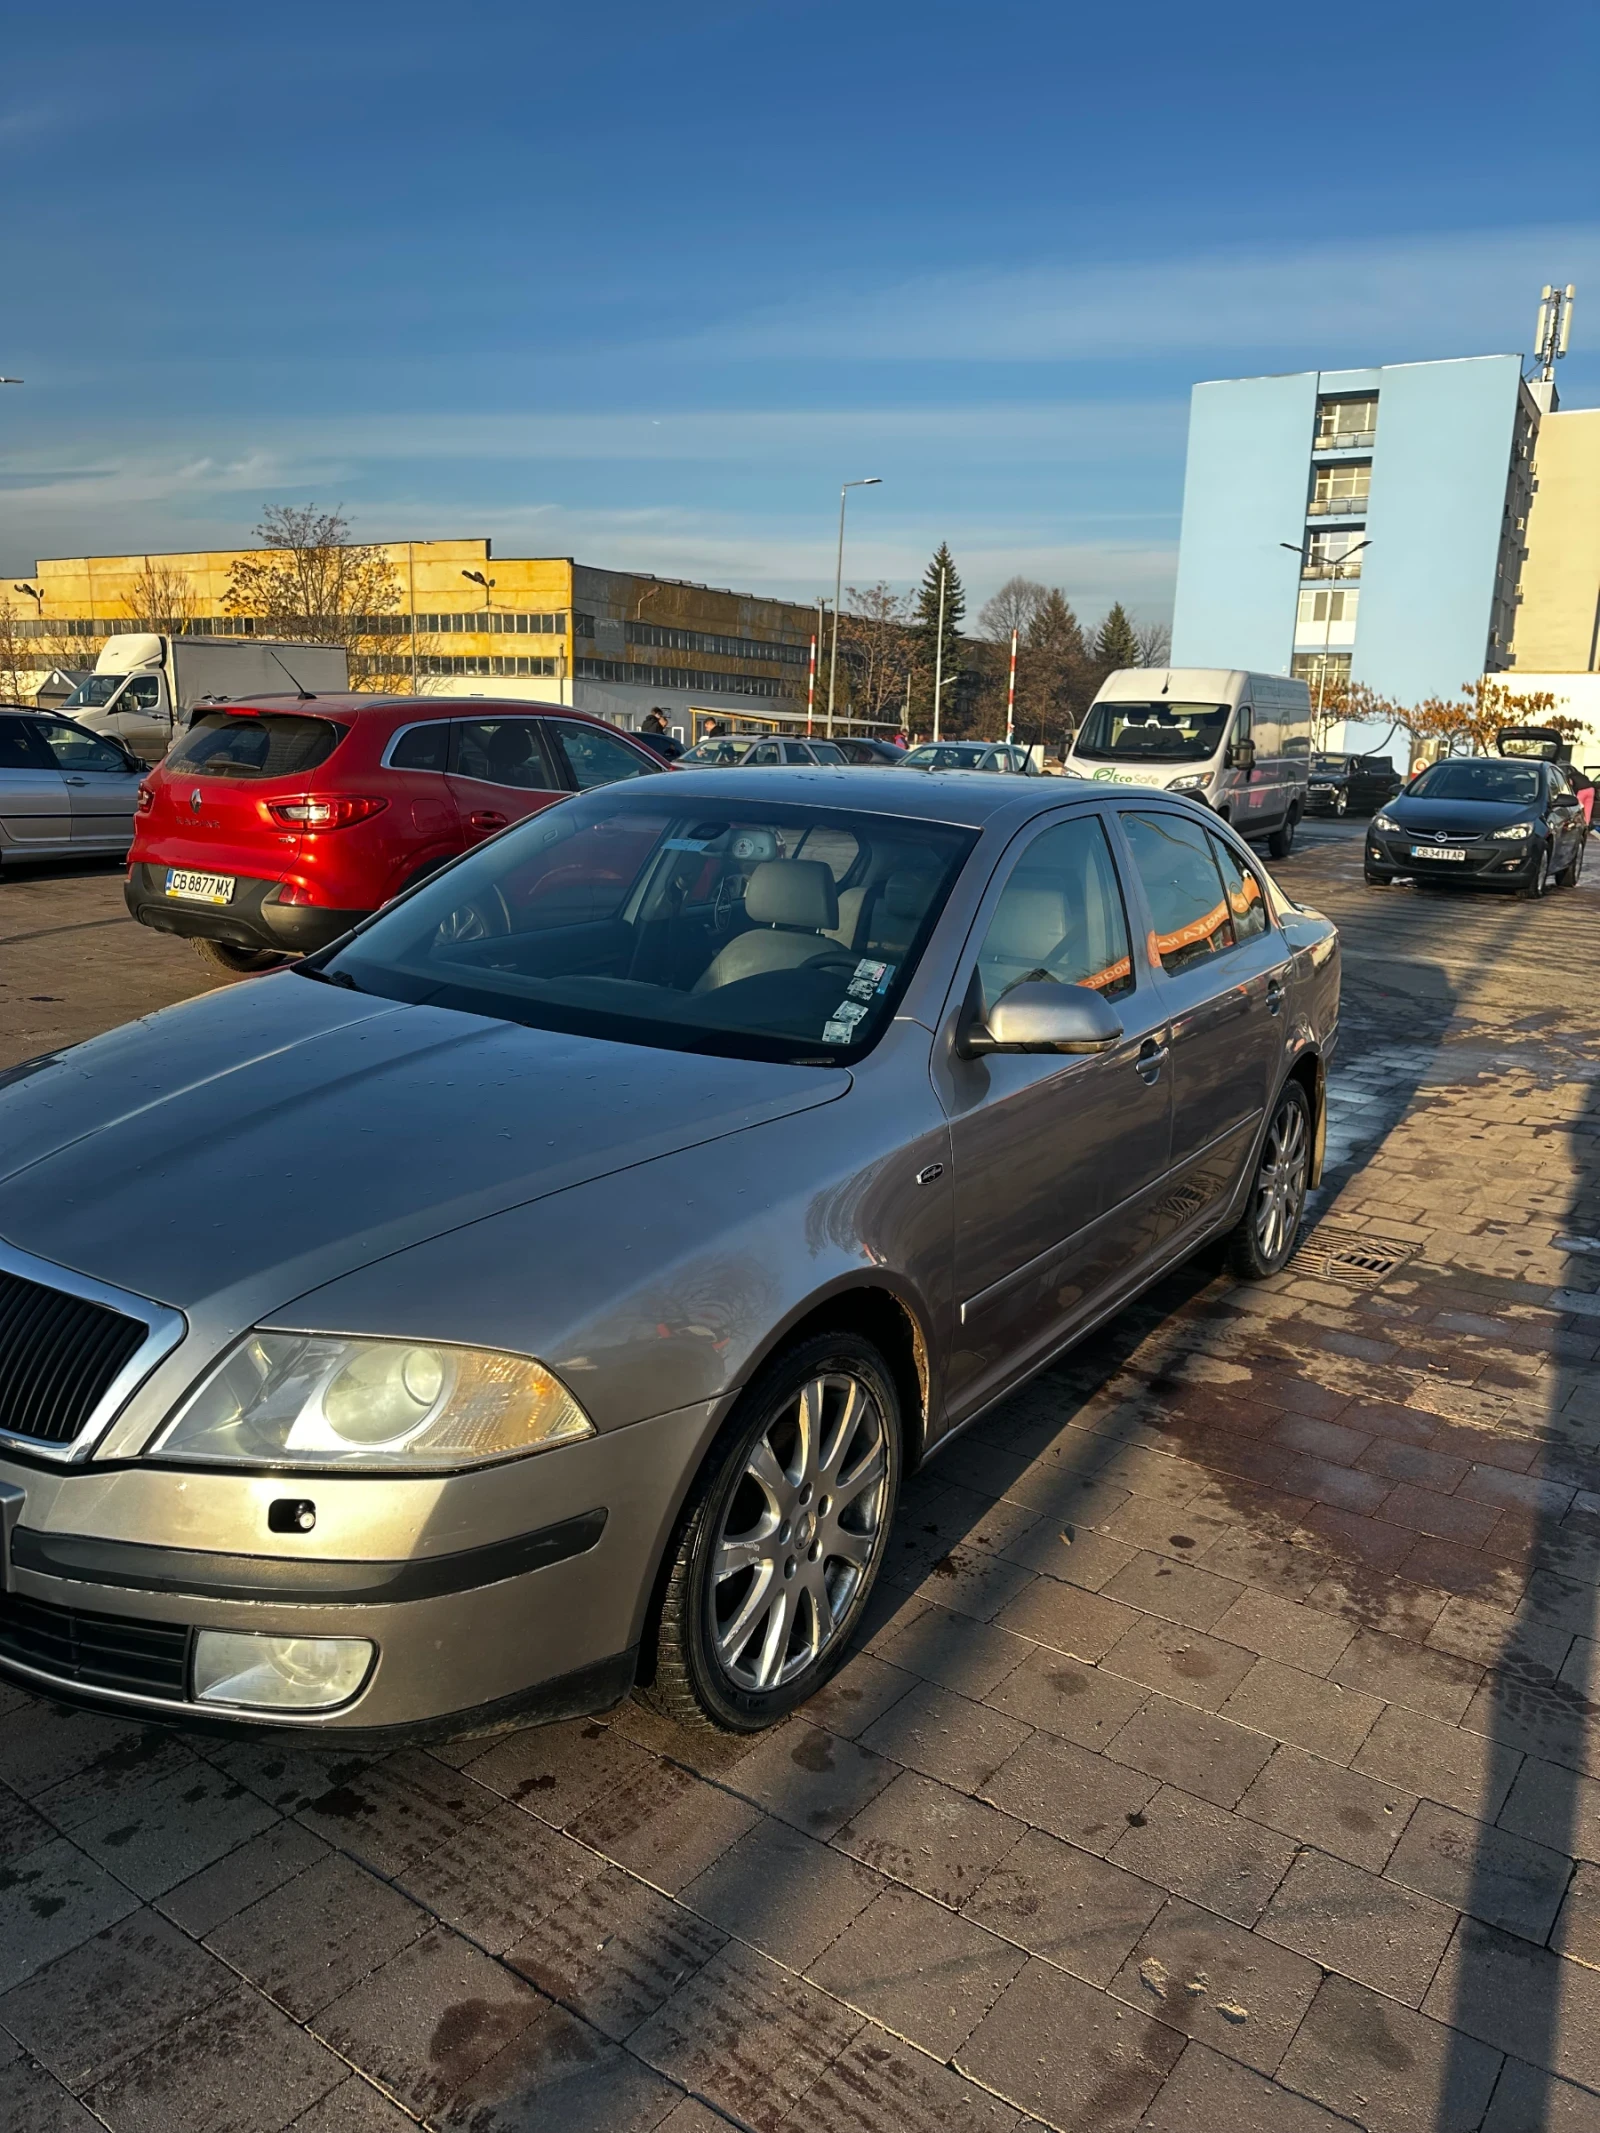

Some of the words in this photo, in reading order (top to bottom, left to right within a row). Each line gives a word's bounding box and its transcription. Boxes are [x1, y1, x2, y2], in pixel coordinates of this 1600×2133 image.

[1417, 848, 1429, 857] CB
[1429, 849, 1450, 859] 3411
[1452, 851, 1464, 860] AP
[172, 873, 188, 890] CB
[188, 875, 215, 894] 8877
[215, 879, 232, 897] MX
